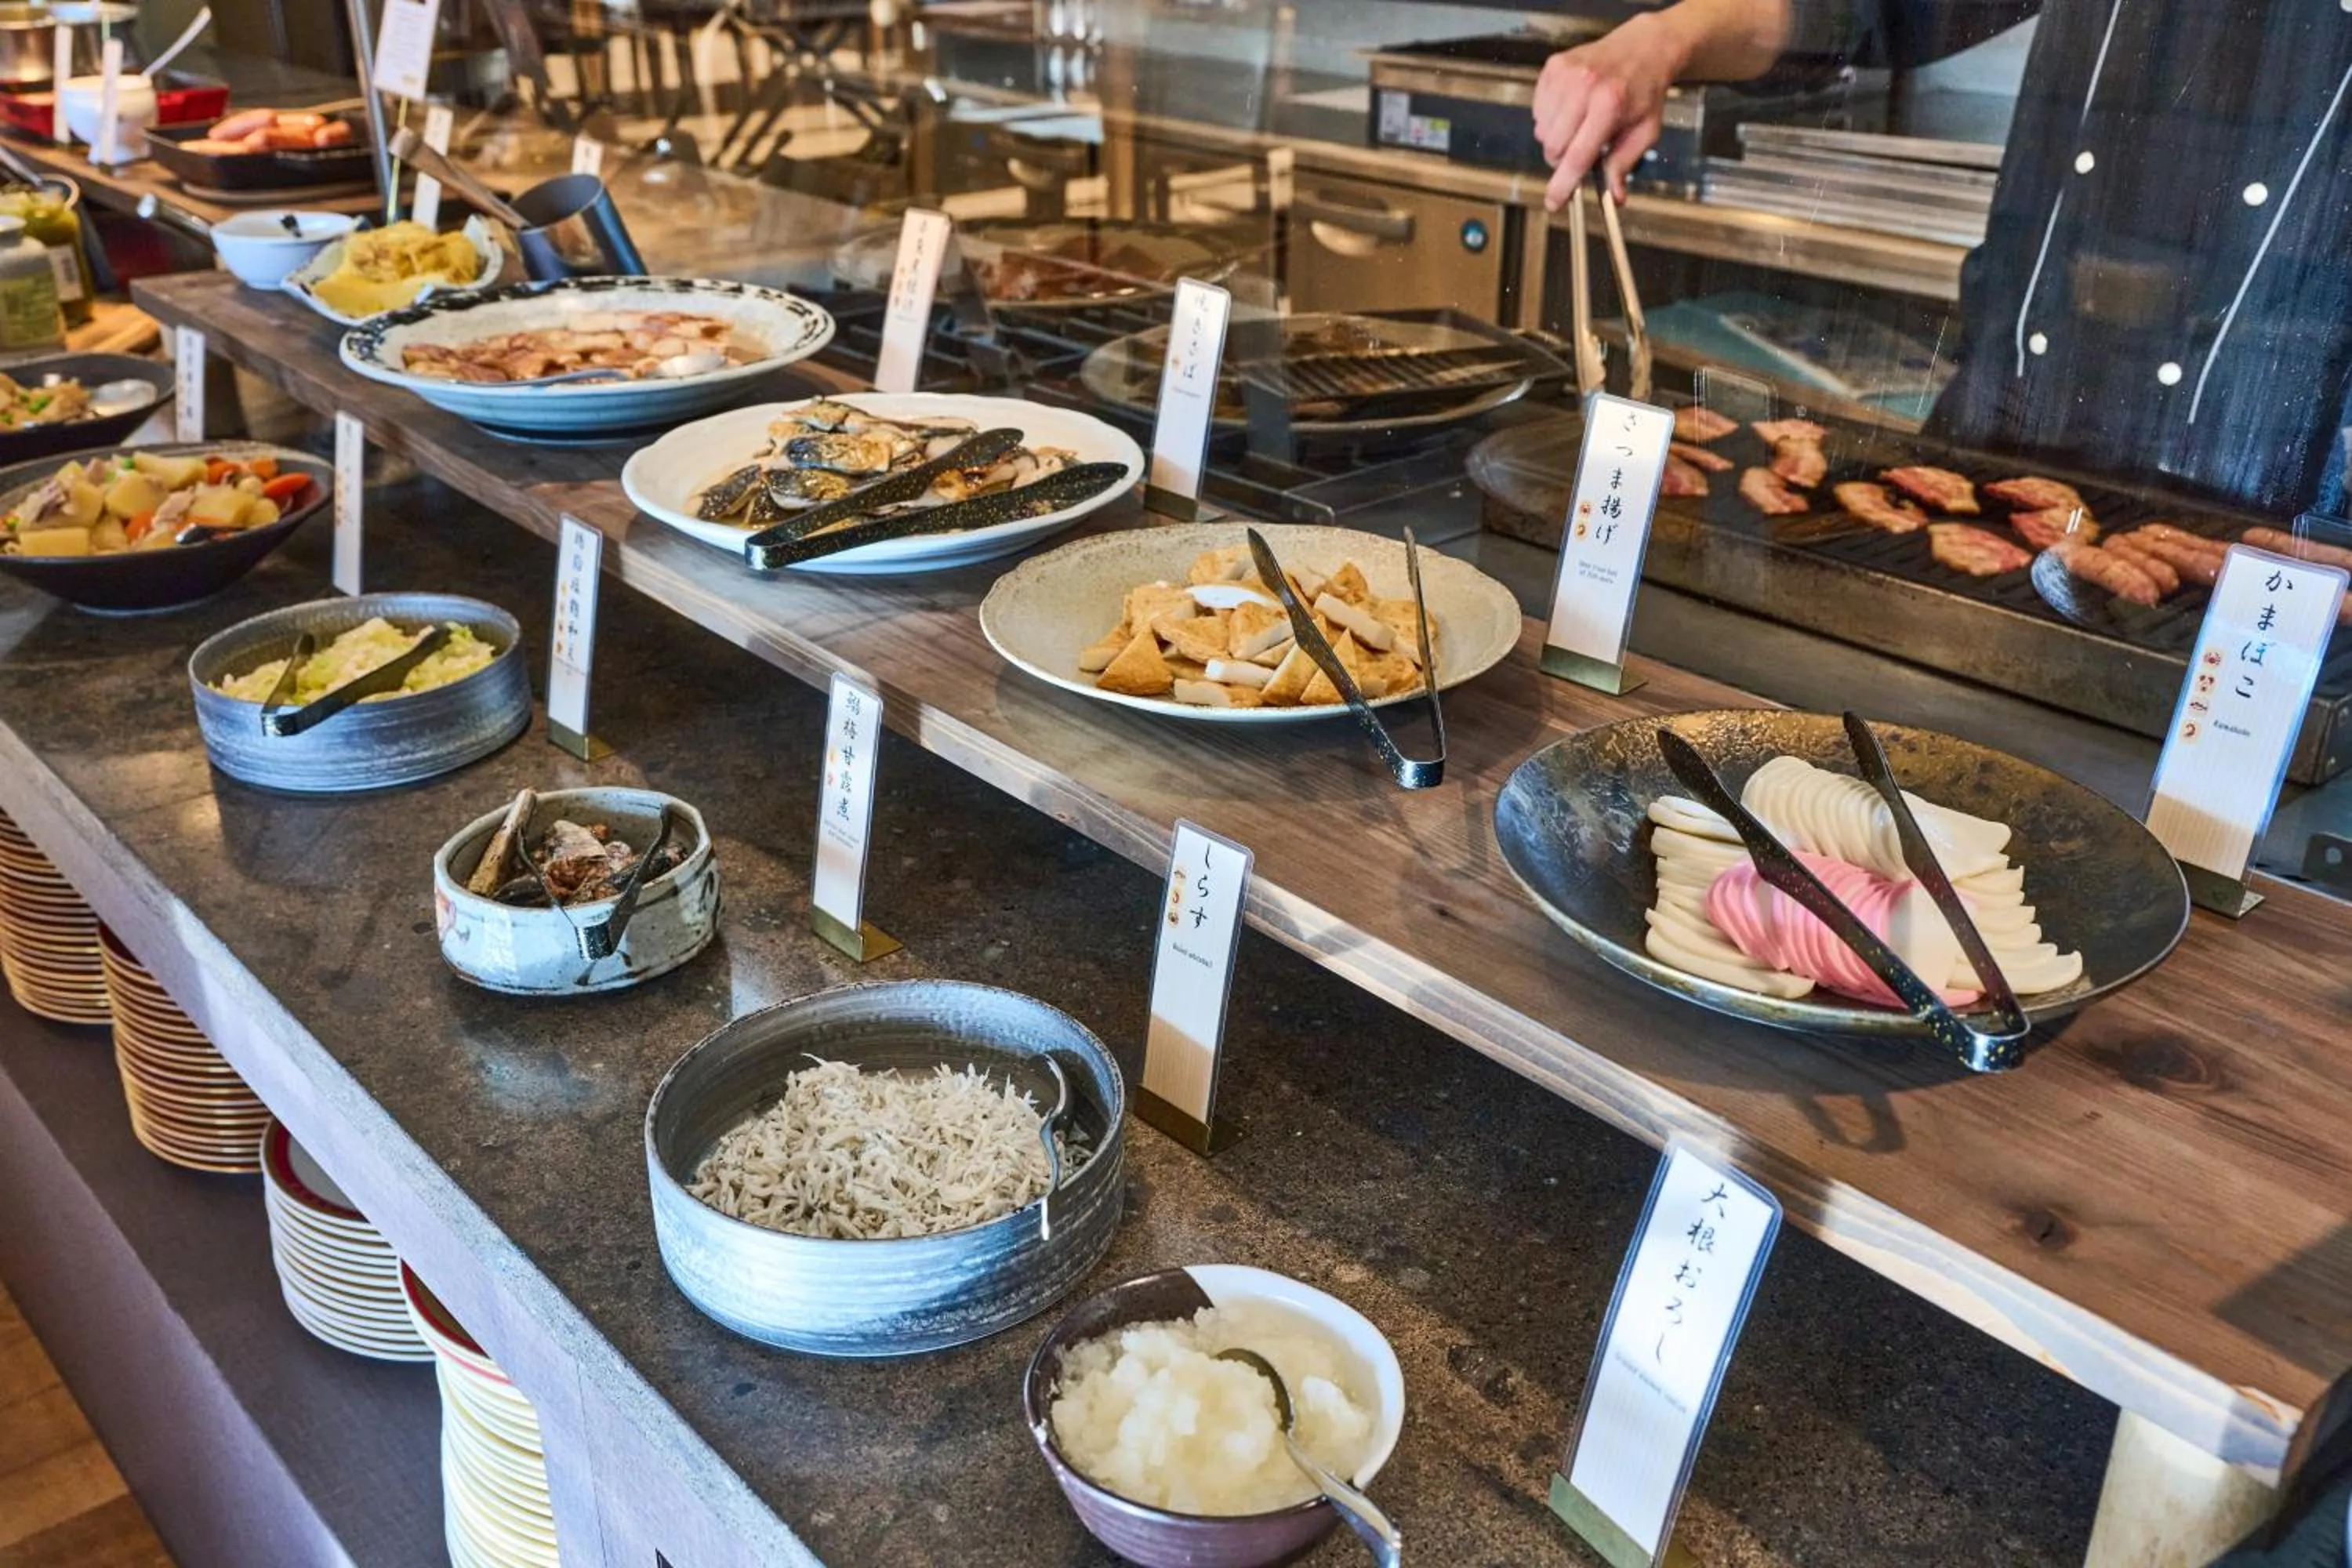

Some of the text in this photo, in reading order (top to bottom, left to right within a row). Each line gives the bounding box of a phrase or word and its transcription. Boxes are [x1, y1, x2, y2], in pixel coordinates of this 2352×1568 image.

[1595, 410, 1638, 547] さつま揚げ
[2234, 569, 2294, 699] かまぼこ
[1189, 842, 1212, 930] しらす
[1654, 1181, 1730, 1367] 大根おろし
